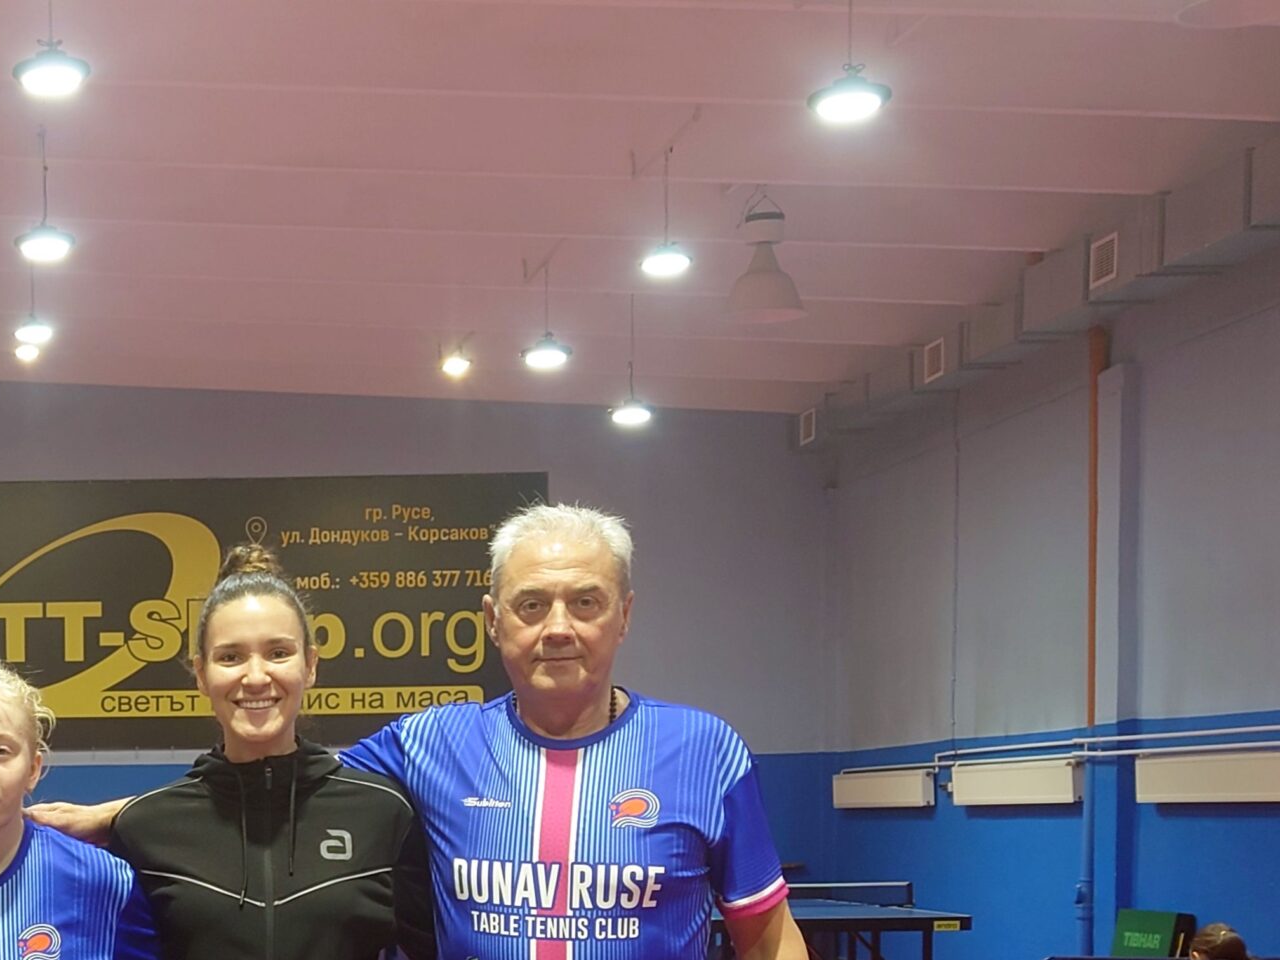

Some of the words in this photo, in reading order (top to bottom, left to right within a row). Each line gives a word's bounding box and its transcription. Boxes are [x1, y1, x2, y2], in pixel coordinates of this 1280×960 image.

[364, 507, 388, 523] гр.
[391, 504, 435, 524] Русе,
[281, 530, 305, 547] ул.
[308, 527, 390, 546] Дондуков
[296, 572, 341, 590] моб.:
[349, 571, 390, 589] +359
[395, 570, 428, 588] 886
[432, 569, 461, 588] 377
[465, 569, 493, 587] 716
[100, 694, 200, 713] светът
[350, 691, 384, 709] на
[453, 858, 560, 909] DUNAV
[571, 863, 665, 910] RUSE
[471, 911, 520, 936] TABLE
[525, 916, 588, 939] TENNIS
[595, 917, 639, 939] CLUB
